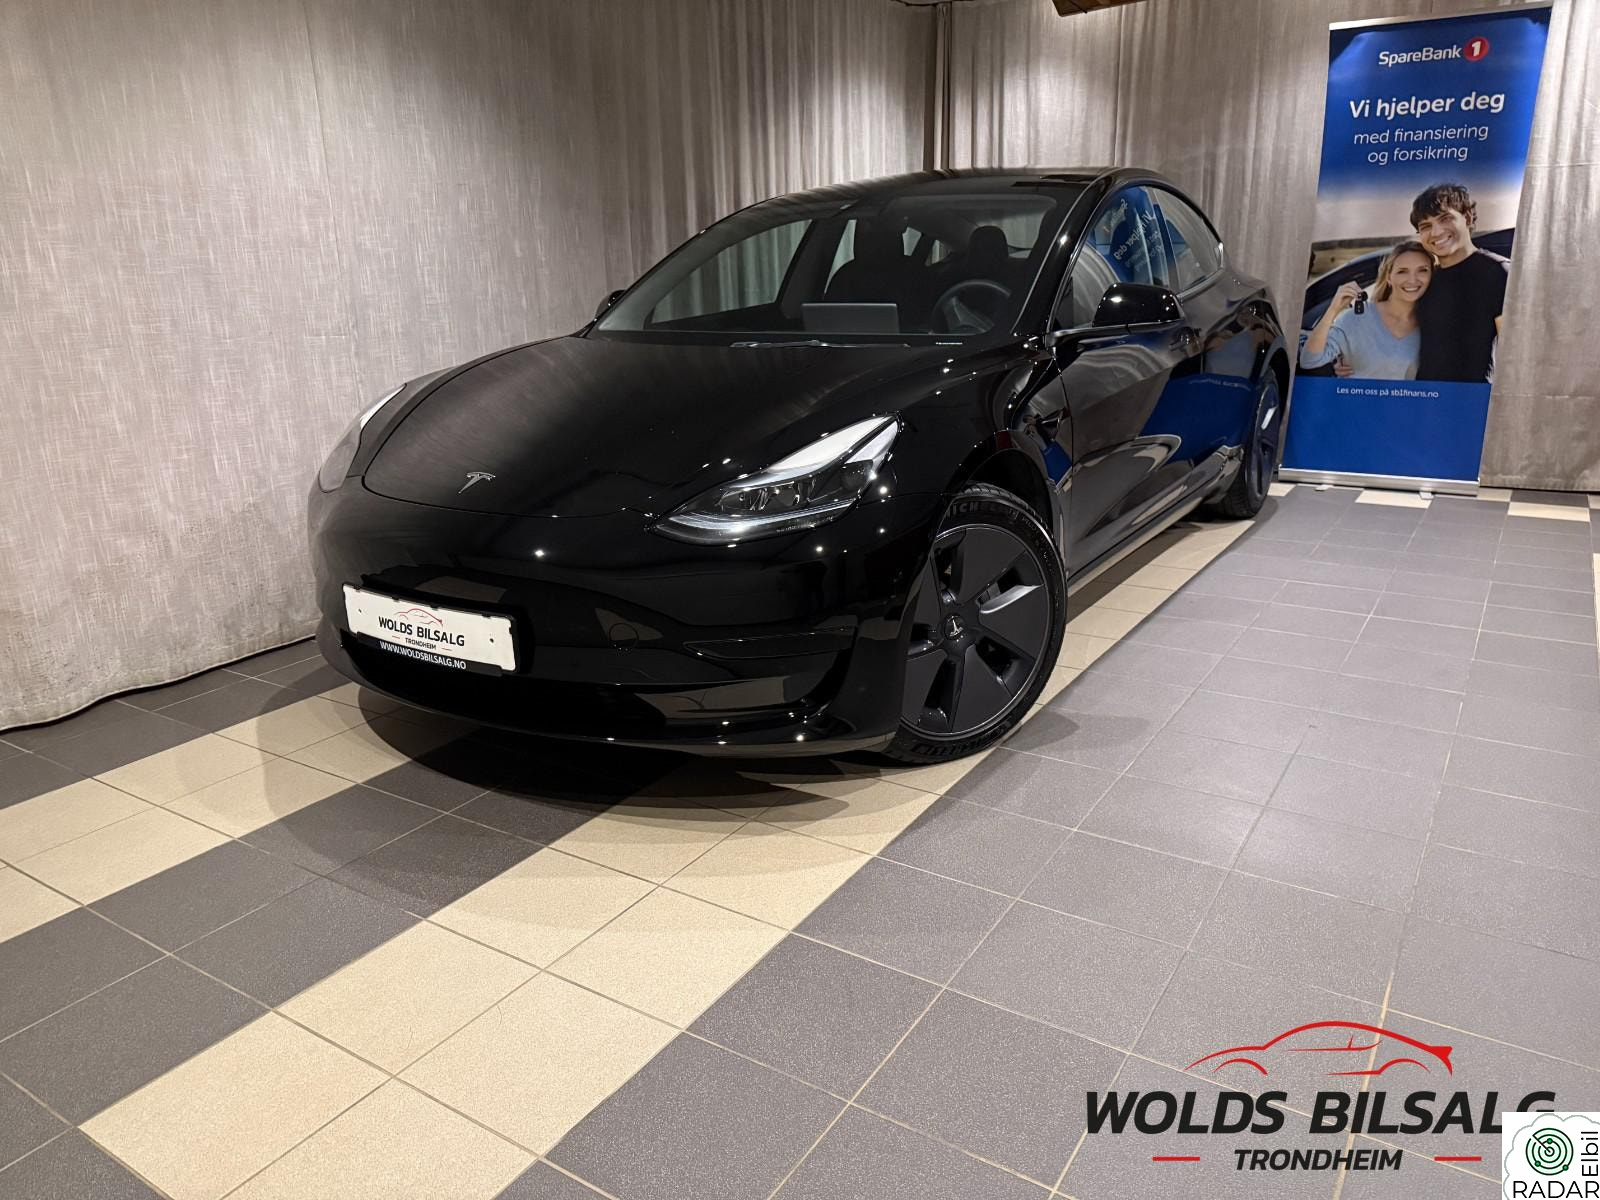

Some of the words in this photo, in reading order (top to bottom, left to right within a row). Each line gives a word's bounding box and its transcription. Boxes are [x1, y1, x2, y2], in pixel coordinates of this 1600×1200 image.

[1379, 45, 1462, 67] SpareBank
[1472, 41, 1481, 57] 1
[1350, 98, 1369, 118] Vi
[1376, 95, 1455, 121] hjelper
[1460, 91, 1505, 114] deg
[1354, 129, 1389, 145] med
[1394, 124, 1489, 143] finansiering
[1367, 151, 1388, 166] og
[1393, 145, 1468, 163] forsikring
[1336, 386, 1349, 394] Les
[1379, 388, 1389, 397] på
[378, 616, 413, 636] WOLDS
[416, 626, 465, 647] BILSALG
[379, 640, 467, 670] WWW.WOLDSBILSALG.NO
[405, 637, 437, 650] TRONDHEIM
